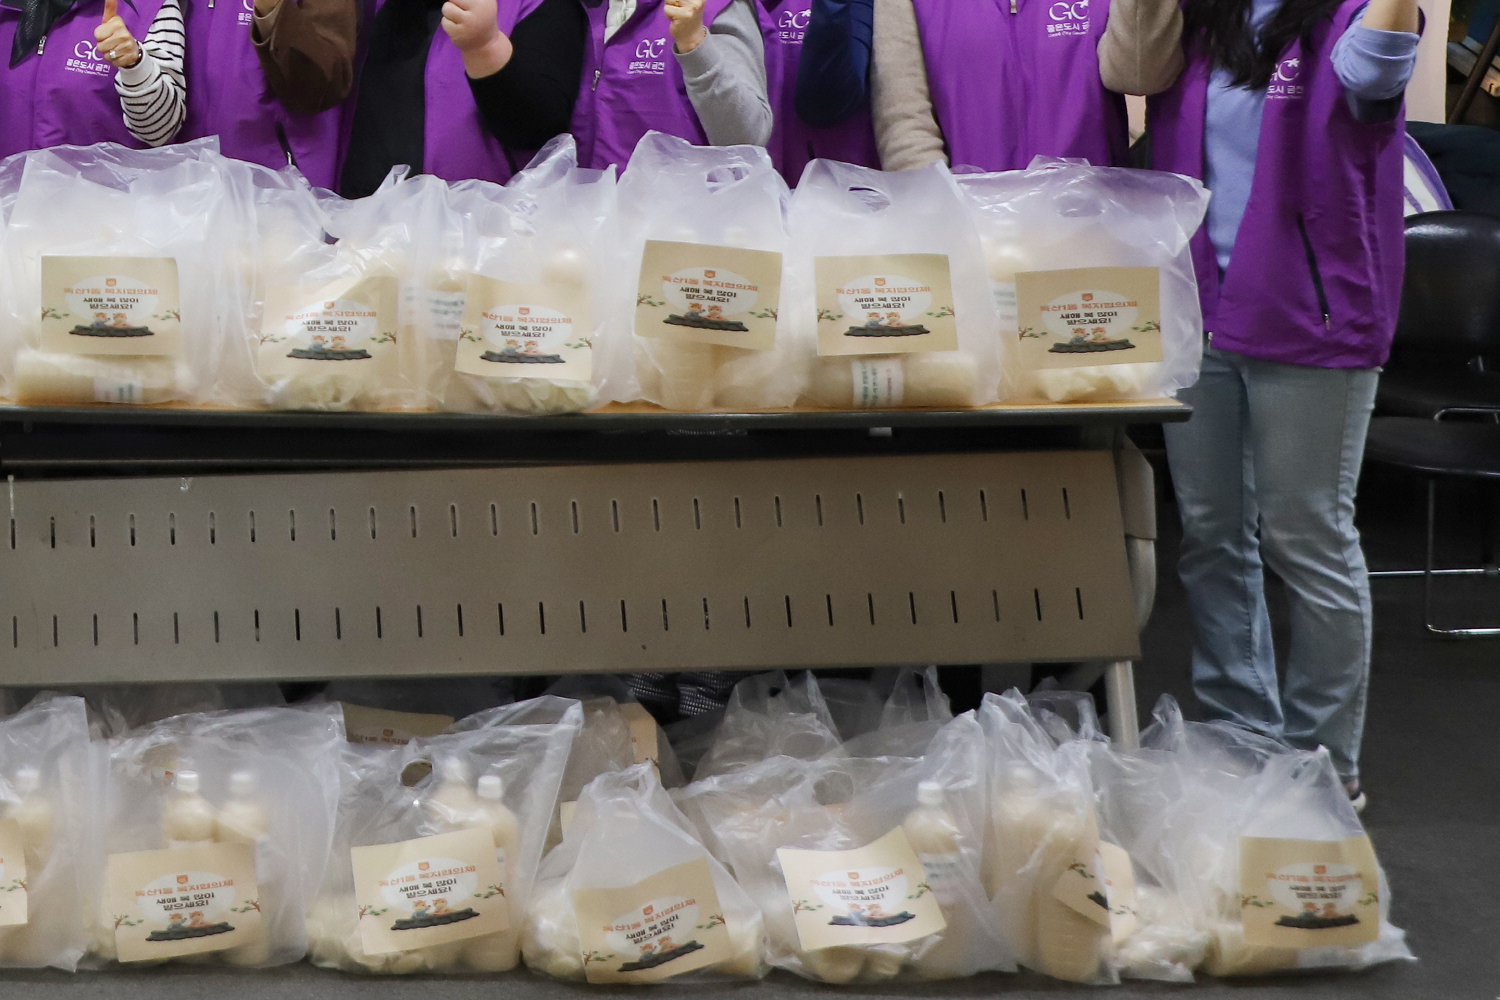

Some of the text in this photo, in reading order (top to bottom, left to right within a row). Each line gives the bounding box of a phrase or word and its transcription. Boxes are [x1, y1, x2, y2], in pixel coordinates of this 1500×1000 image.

[1046, 21, 1090, 32] 좋은도시 금
[66, 59, 111, 73] 좋은도시 금천
[629, 61, 665, 71] 좋은도시 금천
